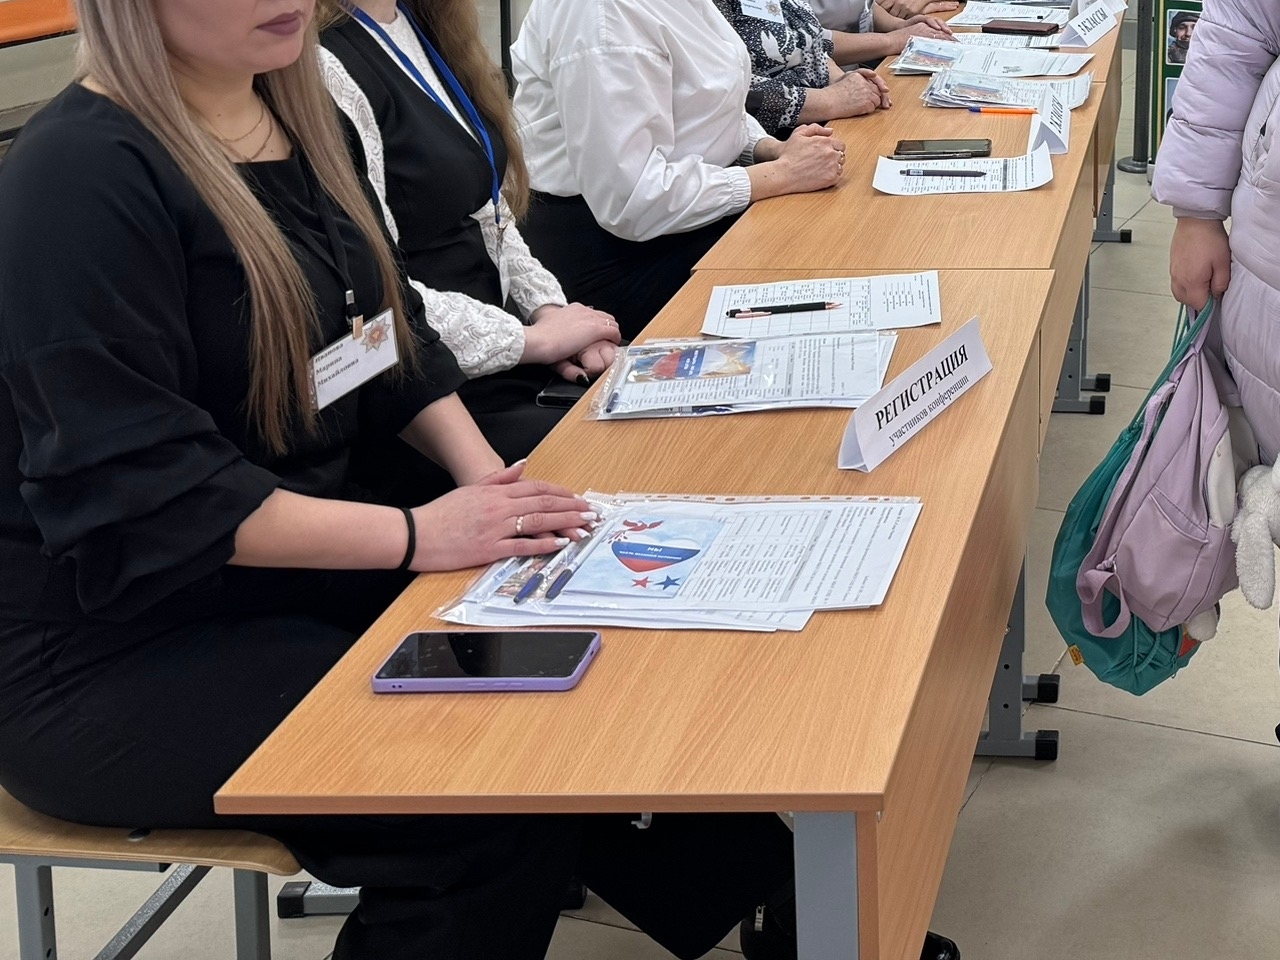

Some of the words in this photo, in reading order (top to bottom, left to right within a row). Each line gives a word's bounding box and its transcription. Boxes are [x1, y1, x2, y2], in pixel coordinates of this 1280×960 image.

[875, 344, 968, 431] РЕГИСТРАЦИЯ
[889, 408, 929, 447] участников
[927, 375, 969, 413] конференции
